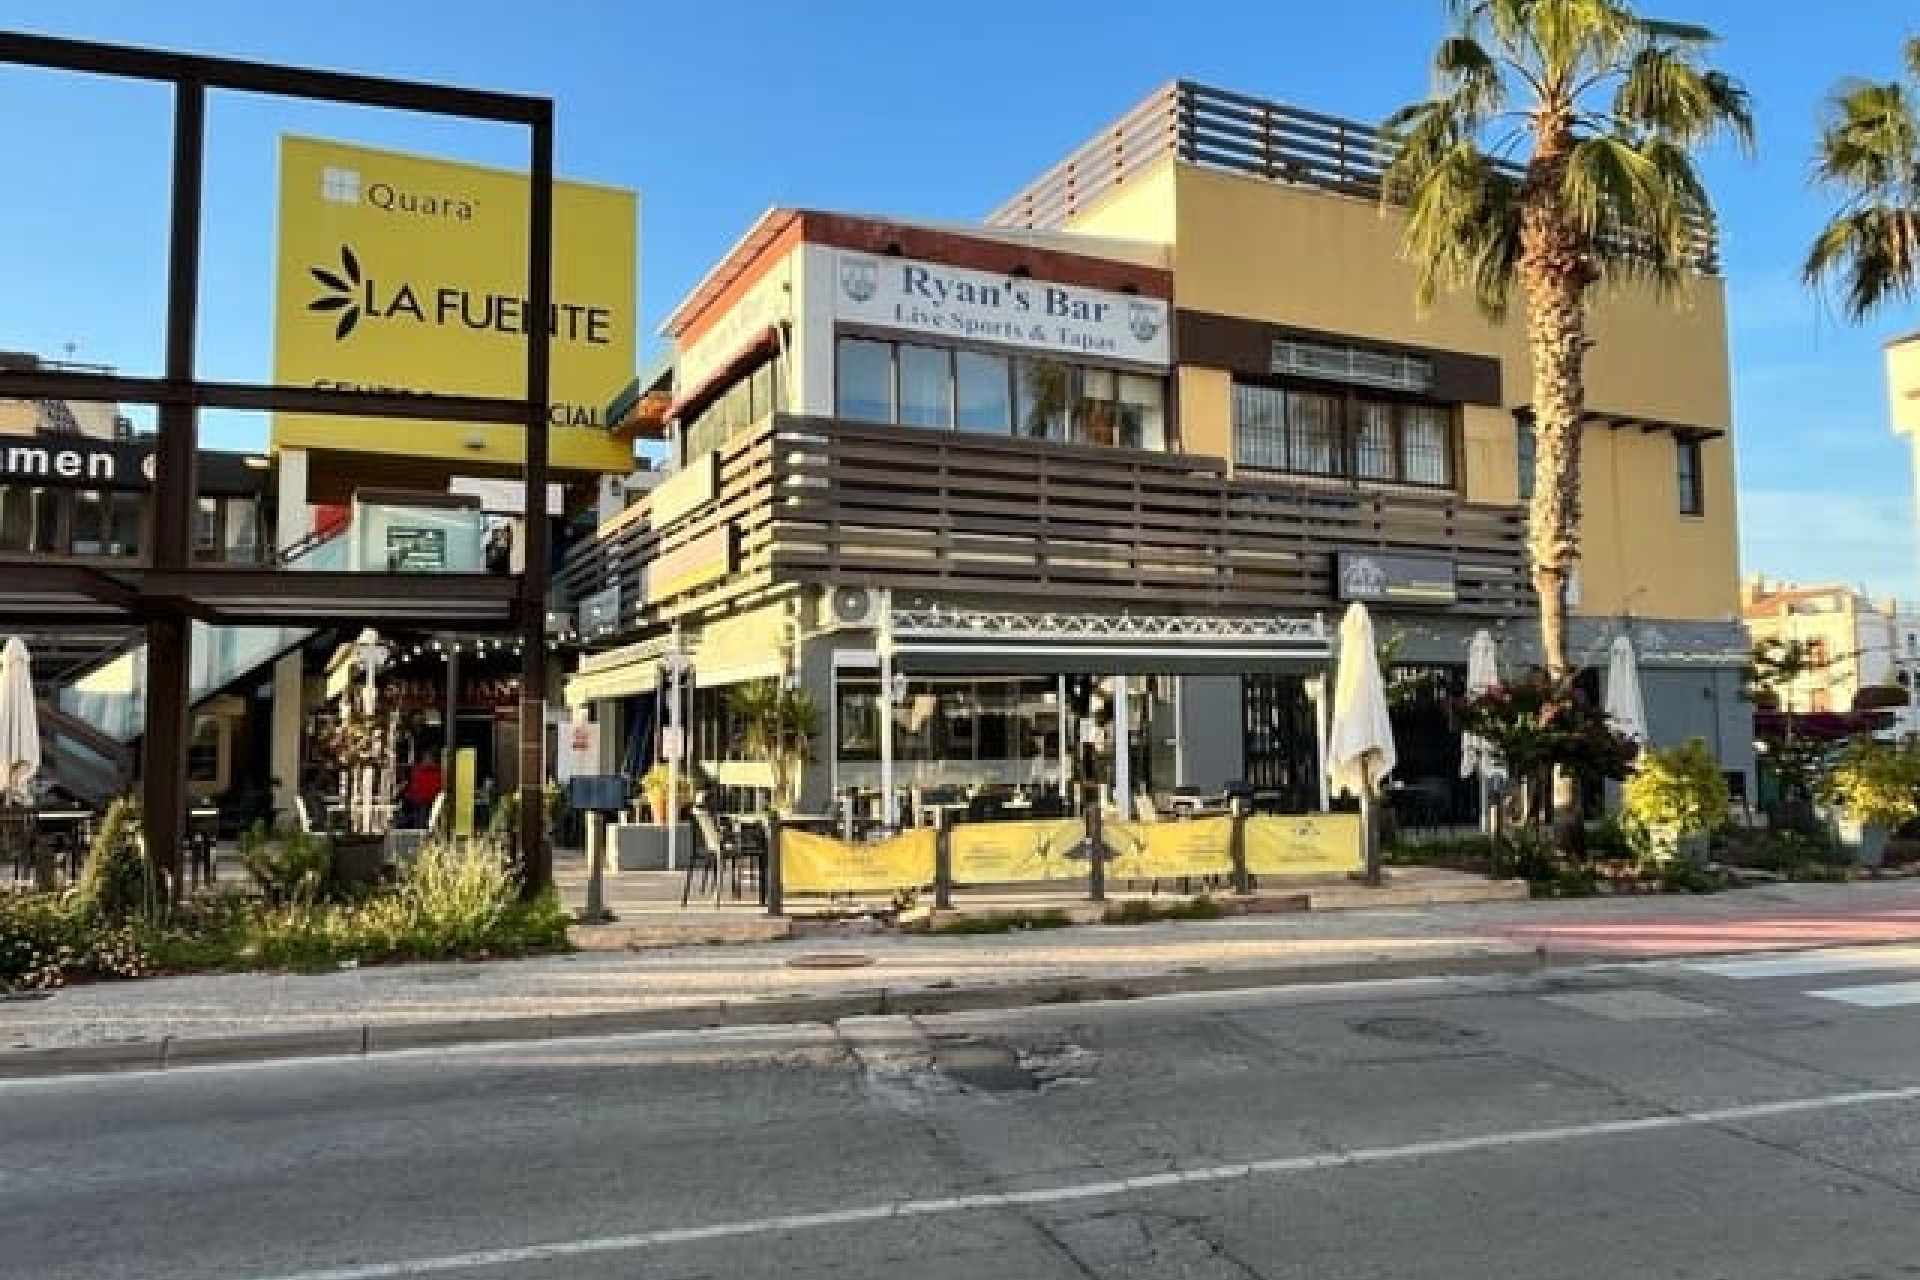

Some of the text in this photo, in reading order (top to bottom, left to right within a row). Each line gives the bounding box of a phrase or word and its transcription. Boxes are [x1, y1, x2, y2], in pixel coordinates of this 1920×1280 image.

[368, 183, 474, 221] Quara
[364, 279, 426, 322] LA
[903, 265, 1110, 322] Ryan's Bar
[894, 303, 1116, 351] Live Sports & Tapas
[546, 402, 605, 429] CIAL
[0, 448, 115, 479] men
